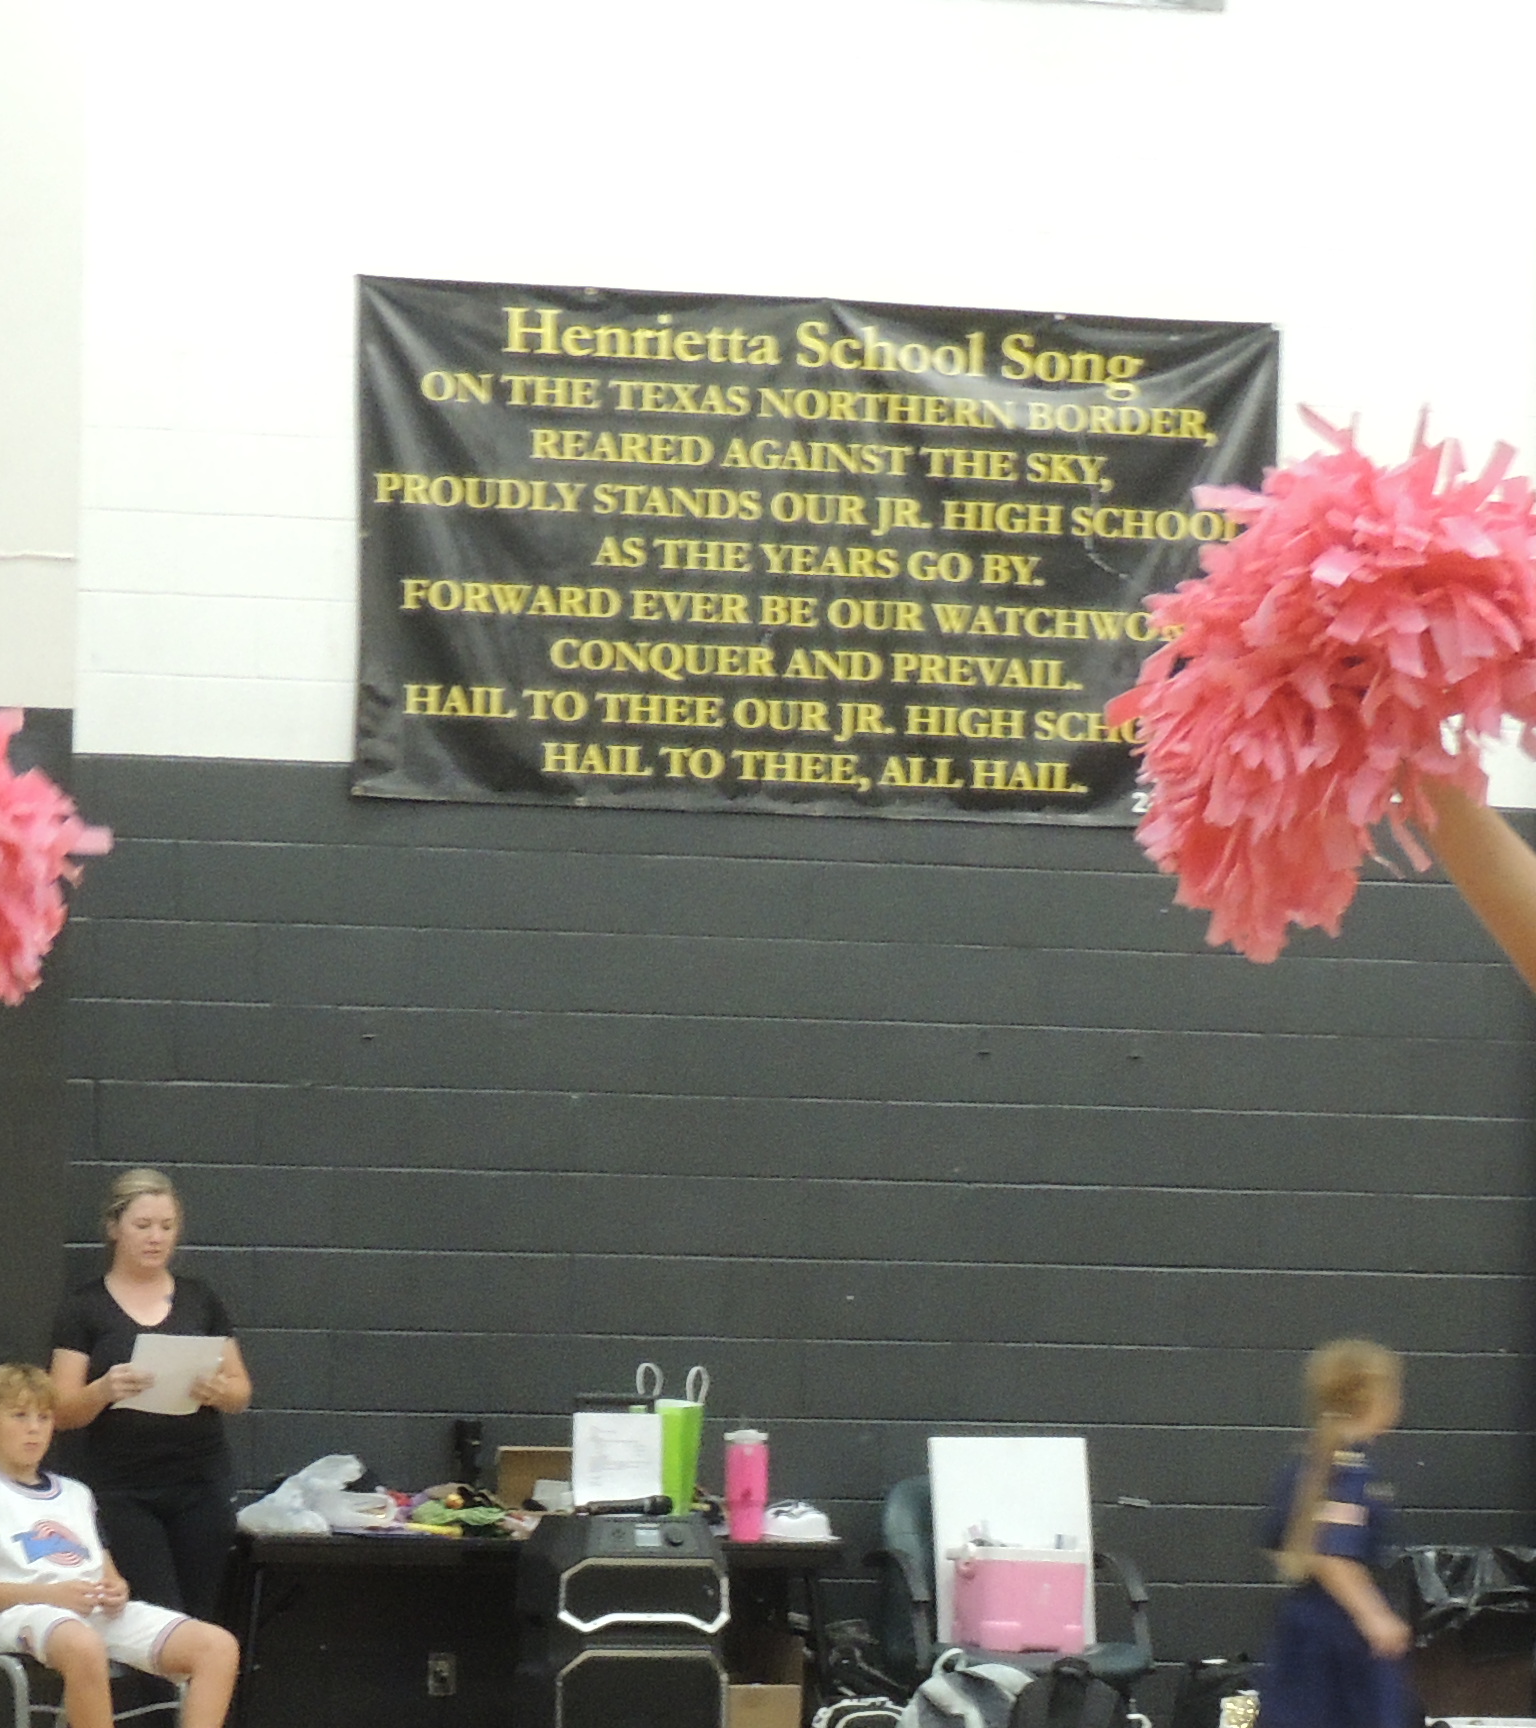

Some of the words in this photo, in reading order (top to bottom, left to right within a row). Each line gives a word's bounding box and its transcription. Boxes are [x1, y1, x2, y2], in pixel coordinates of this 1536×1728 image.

[505, 307, 782, 367] Henrietta
[796, 321, 987, 377] School
[1001, 332, 1145, 400] Song
[421, 371, 494, 403] ON
[502, 374, 600, 409] THE
[612, 380, 752, 416] TEXAS
[759, 388, 1016, 429] NORTHERN
[1028, 400, 1217, 445] BORDER,
[533, 428, 715, 466] REARED
[721, 438, 914, 476] AGAINST
[922, 447, 1020, 481] THE
[1027, 452, 1114, 491] SKY,
[376, 472, 586, 513] PROUDLY
[594, 483, 763, 521] STANDS
[771, 492, 869, 526] OUR
[872, 497, 933, 537] JR.
[944, 500, 1064, 536] HIGH
[597, 536, 648, 568] AS
[654, 538, 752, 572] THE
[760, 542, 902, 578] YEARS
[907, 550, 974, 583] GO
[981, 553, 1044, 586] BY.
[403, 579, 624, 618] FORWARD
[631, 588, 751, 624] EVER
[761, 595, 820, 628] BE
[827, 598, 926, 632] OUR
[933, 603, 1184, 642] WATCHWO
[550, 637, 778, 678] CONQUER
[785, 648, 884, 683] AND
[891, 651, 1084, 691] PREVAIL.
[405, 684, 516, 718] HAIL
[525, 689, 590, 722] TO
[596, 692, 726, 727] THEE
[731, 697, 832, 731] OUR
[834, 702, 896, 742] JR.
[905, 705, 1027, 739] HIGH
[1035, 710, 1147, 745] SCHO
[543, 742, 653, 777] HAIL
[661, 747, 727, 779] TO
[734, 750, 872, 790] THEE,
[879, 756, 965, 789] ALL
[972, 759, 1088, 793] HAIL.
